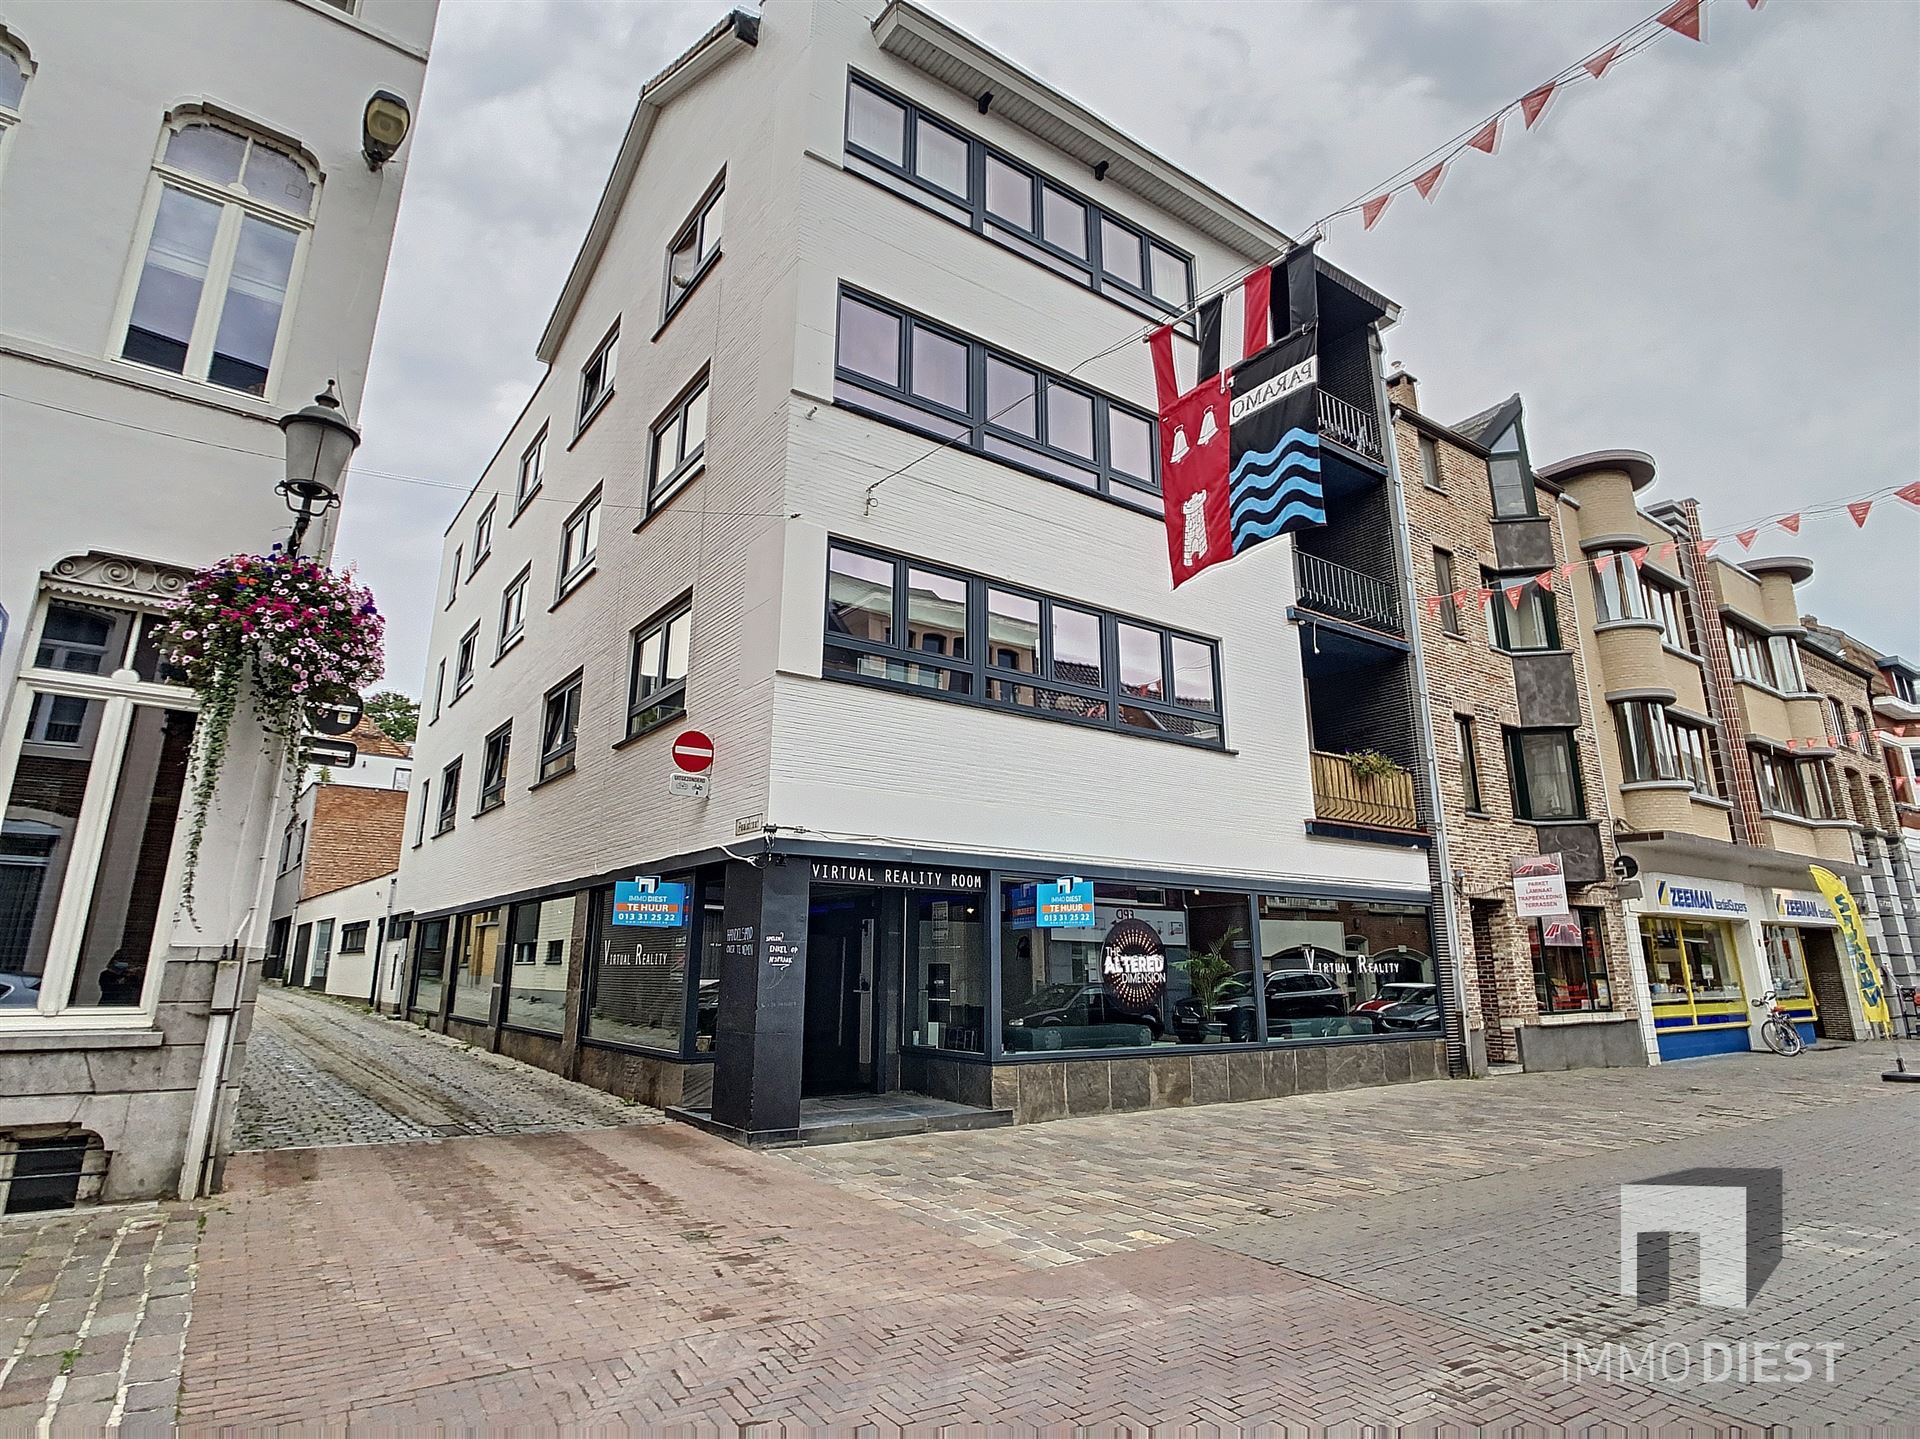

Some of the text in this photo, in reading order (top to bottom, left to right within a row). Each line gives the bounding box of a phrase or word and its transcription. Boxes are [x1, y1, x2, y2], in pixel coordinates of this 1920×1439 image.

[812, 864, 982, 888] VIRTUAL REALITY ROOM
[1065, 895, 1082, 903] DIEST
[1670, 887, 1714, 909] ZEEMAN
[627, 903, 669, 912] TE HUUR
[1050, 904, 1084, 912] TE HUUR
[1784, 899, 1819, 917] ZEEMAN
[618, 913, 675, 922] 013 31 25 22
[1044, 913, 1090, 922] 013 31 25 22
[769, 945, 788, 953] ENKEL
[1105, 947, 1121, 956] THE
[1104, 954, 1165, 974] ALTERED
[1121, 972, 1166, 983] DIMENSION
